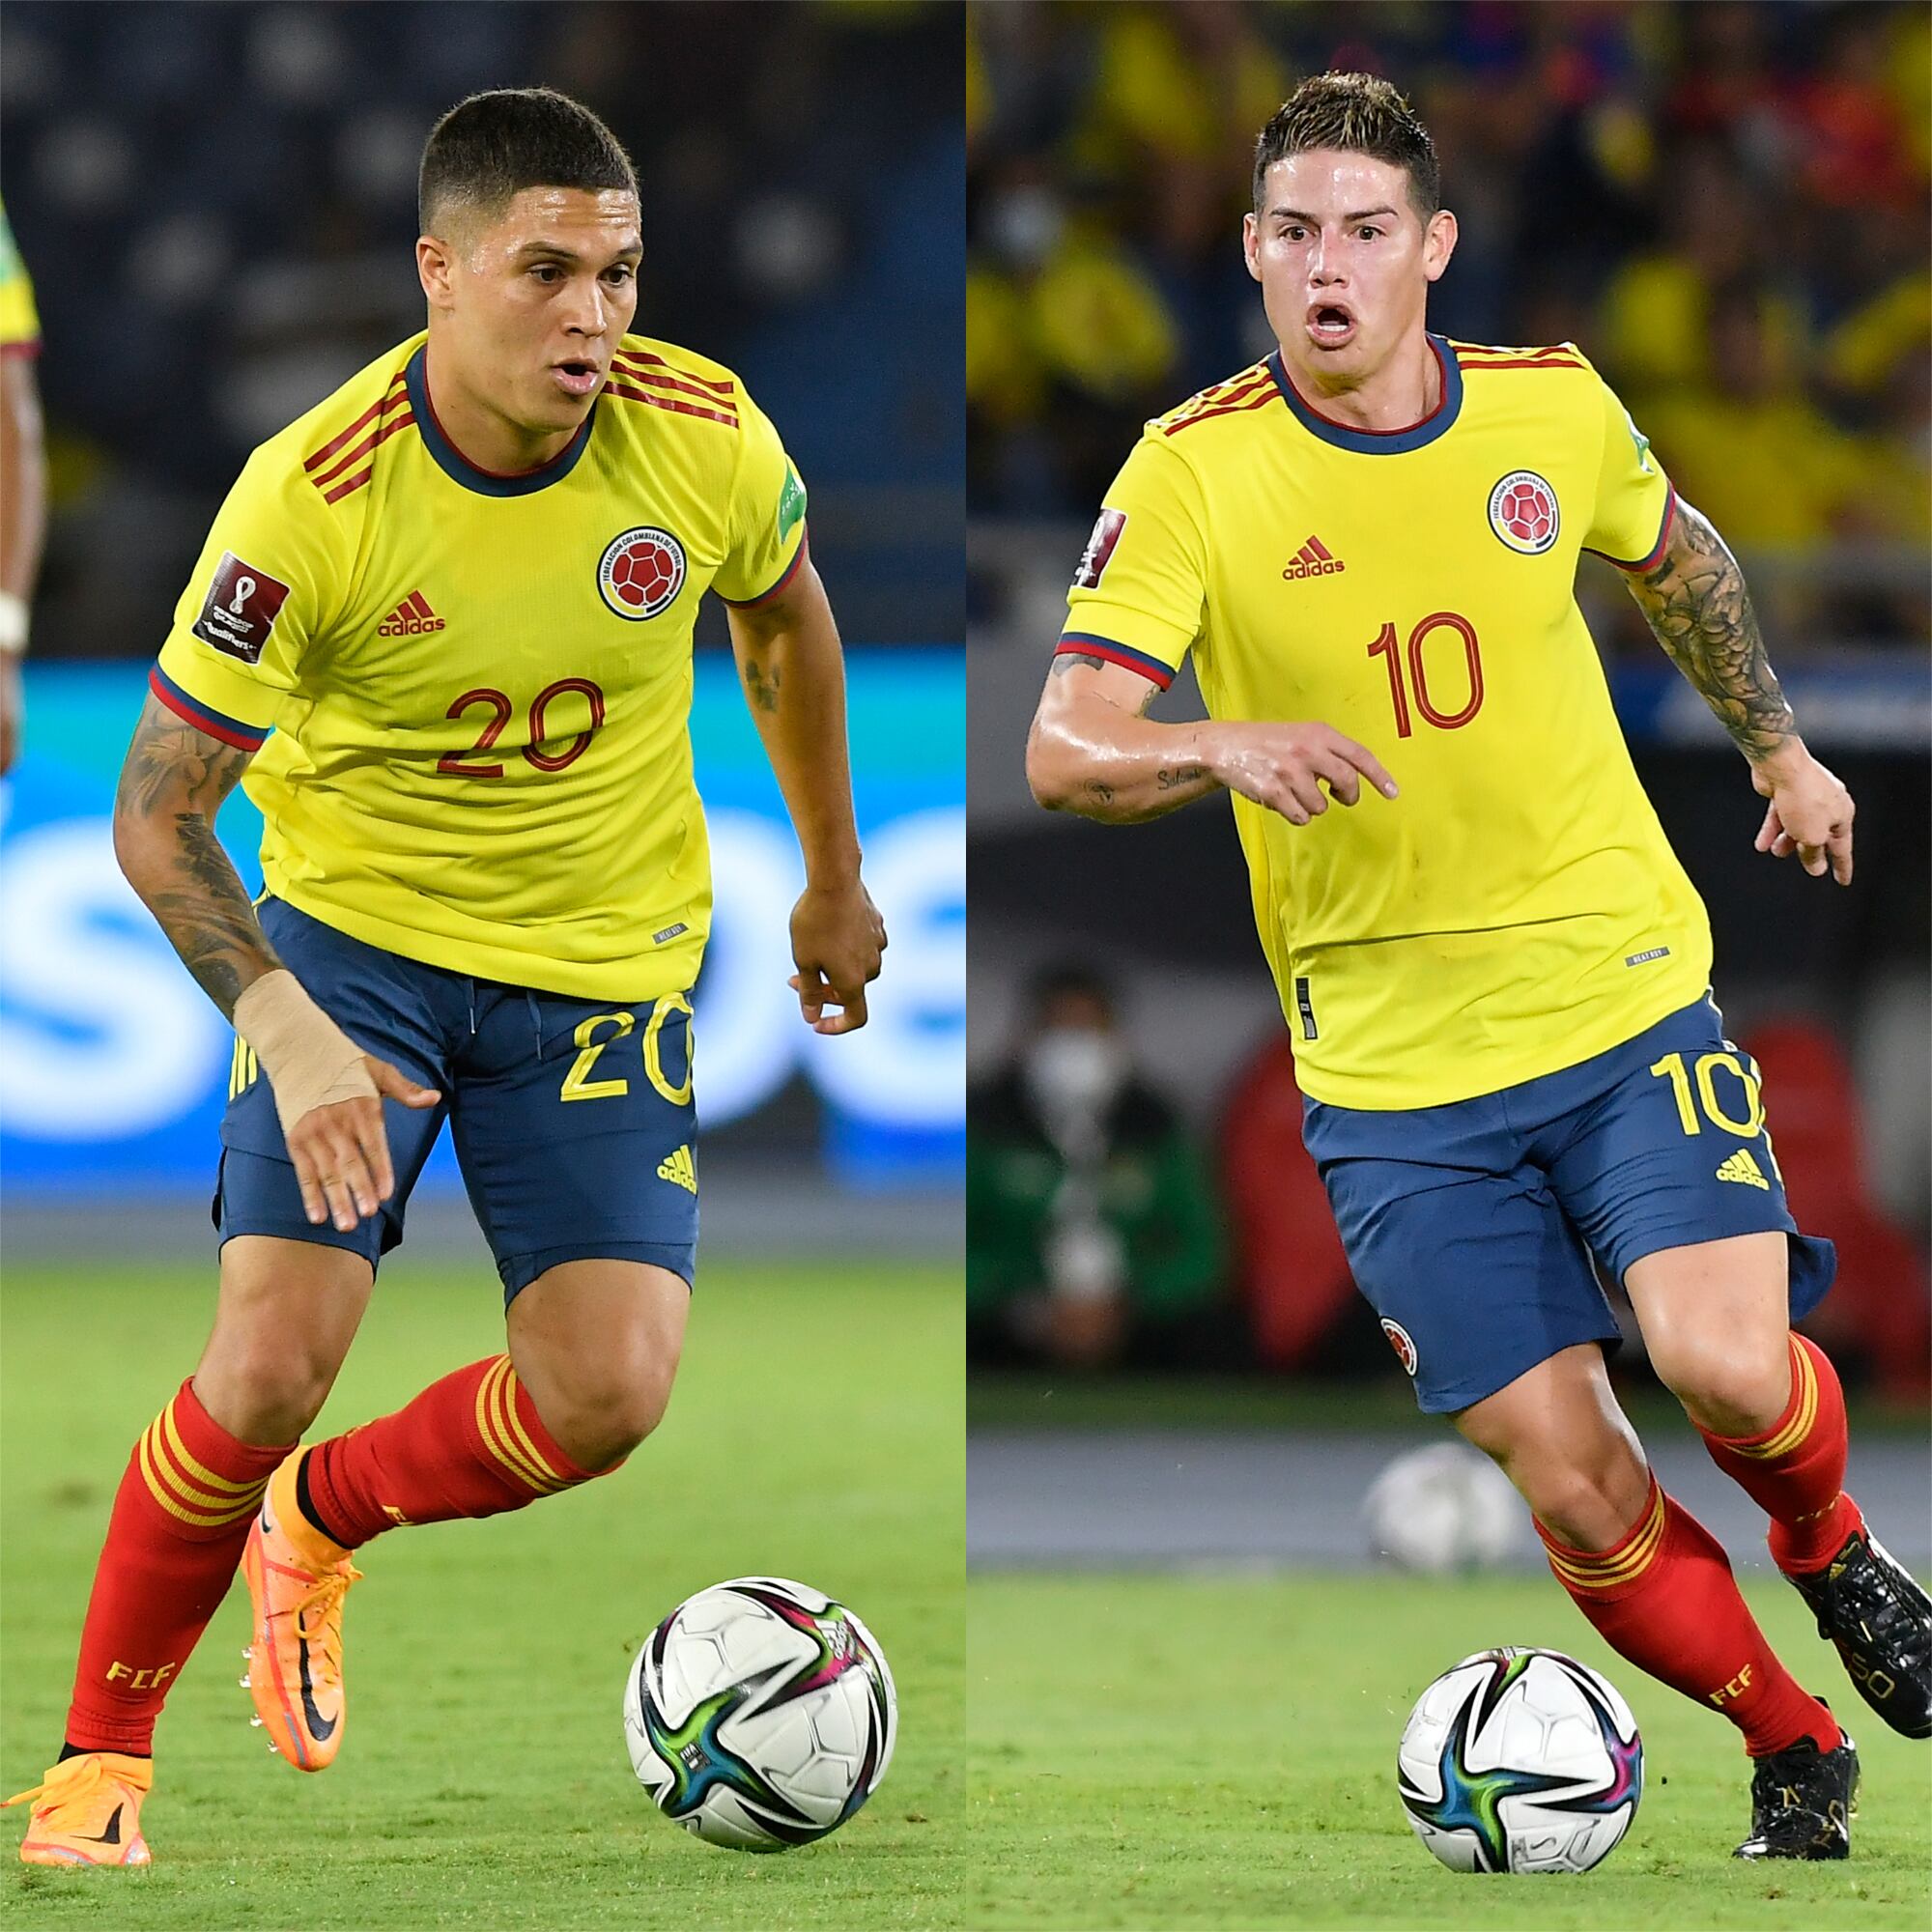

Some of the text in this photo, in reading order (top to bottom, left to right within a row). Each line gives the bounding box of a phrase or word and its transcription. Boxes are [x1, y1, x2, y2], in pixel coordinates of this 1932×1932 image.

[1282, 560, 1345, 581] adidas
[378, 618, 445, 637] adidas
[1367, 611, 1484, 738] 10
[437, 678, 605, 778] 20
[560, 992, 695, 1106] 20
[1650, 1052, 1760, 1138] 10
[106, 1661, 176, 1690] FCF
[1709, 1663, 1751, 1706] FCF
